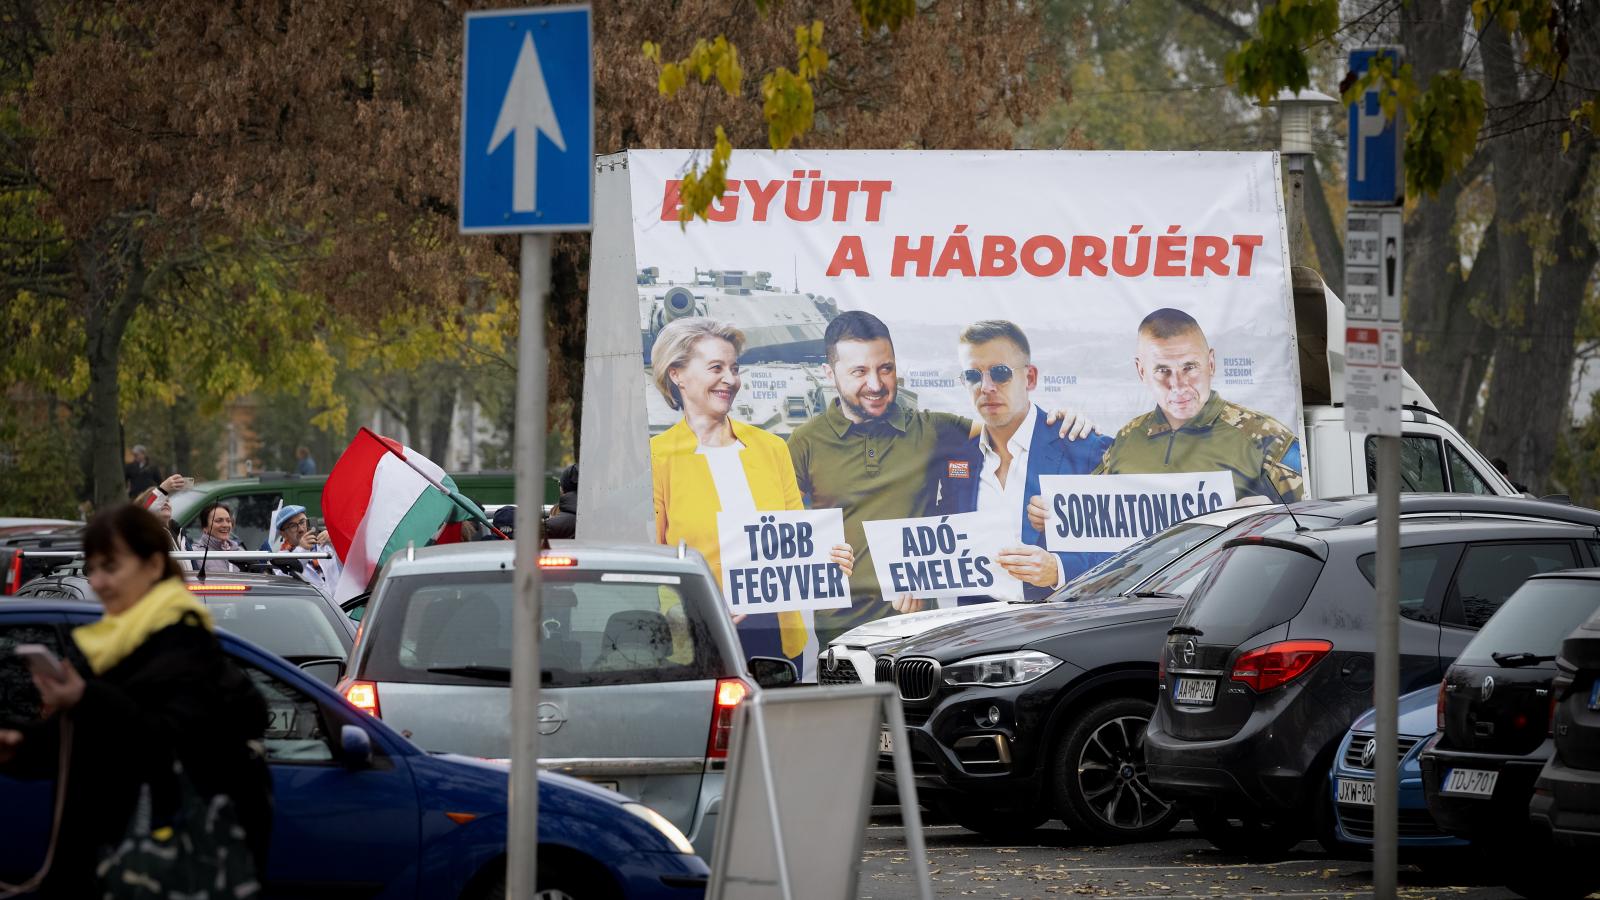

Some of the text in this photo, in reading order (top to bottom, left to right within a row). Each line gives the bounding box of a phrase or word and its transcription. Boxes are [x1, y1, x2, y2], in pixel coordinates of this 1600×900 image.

[826, 225, 1263, 277] A HÁBORÚÉRT
[1044, 376, 1077, 384] MAGYAR
[1223, 358, 1255, 366] RUSZIN-
[753, 391, 777, 399] LEYEN
[744, 515, 814, 562] TÖBB
[902, 516, 968, 557] ADÓ-
[729, 562, 845, 605] FEGYVER
[889, 549, 994, 592] EMELÉS
[1451, 770, 1496, 793] TDJ-701
